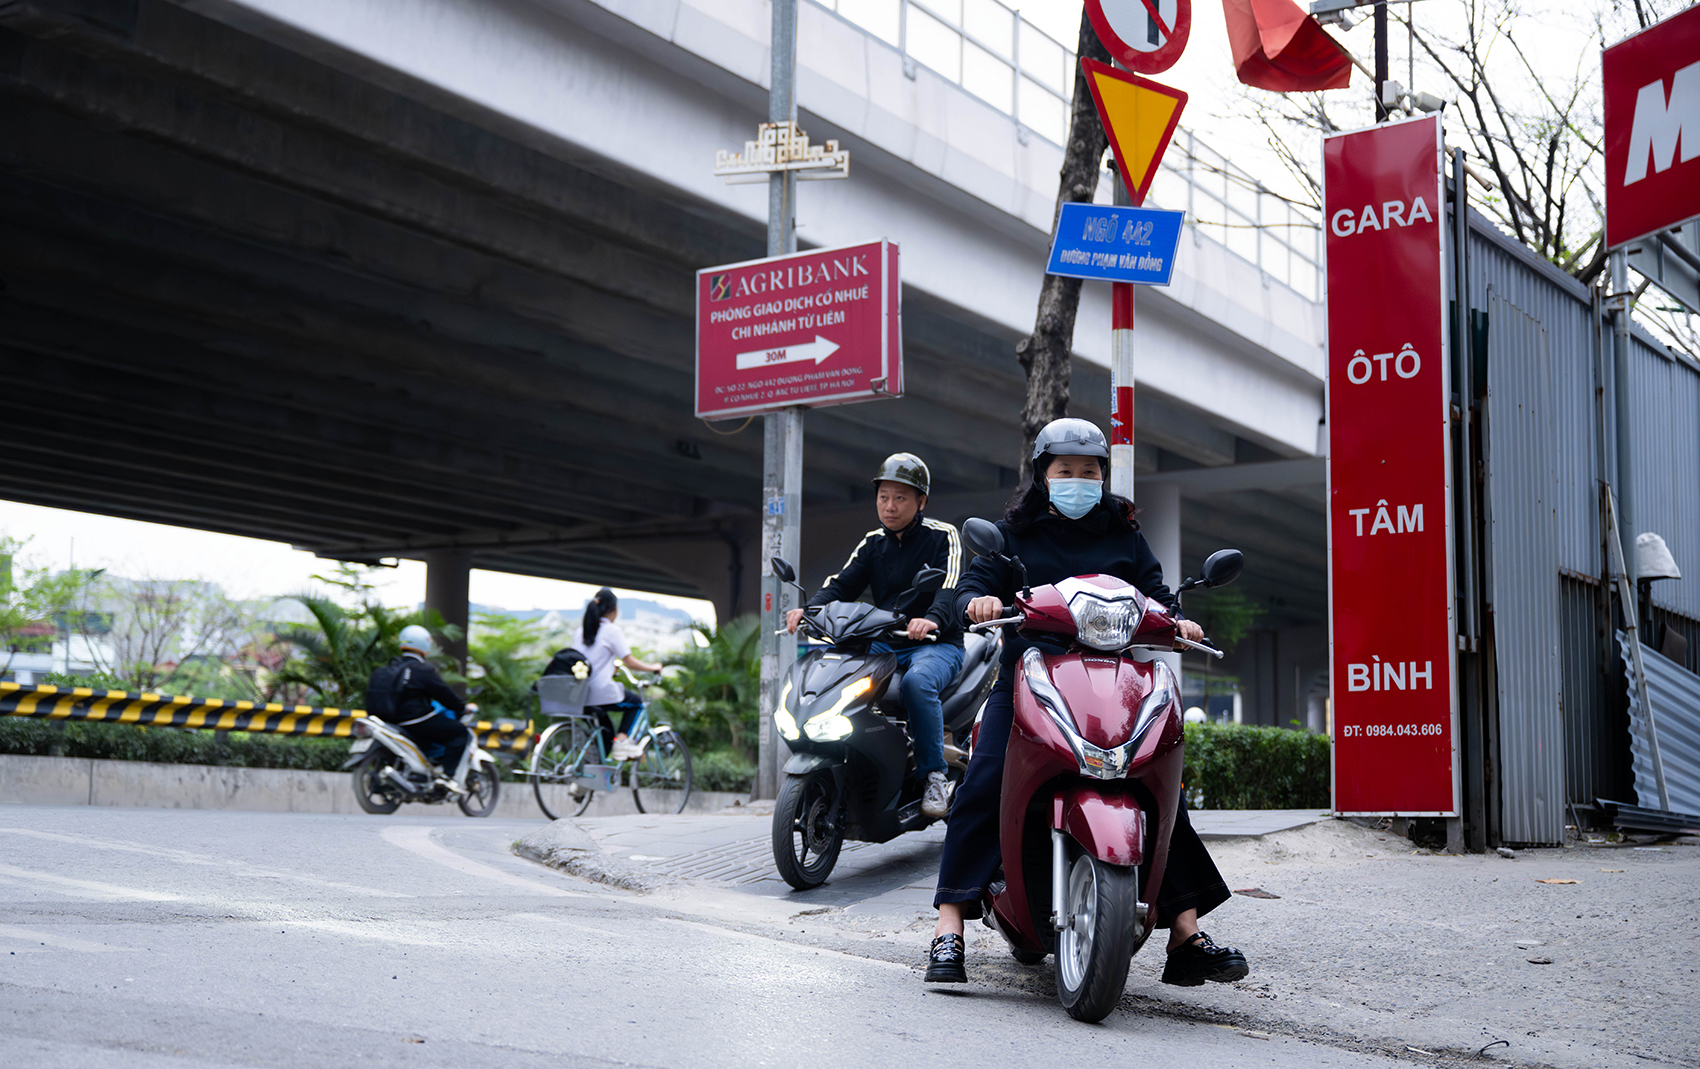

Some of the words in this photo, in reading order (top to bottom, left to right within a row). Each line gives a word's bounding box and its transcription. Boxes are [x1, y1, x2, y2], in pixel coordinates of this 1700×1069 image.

[1082, 213, 1119, 243] NGÕ
[1122, 220, 1154, 246] 442
[1331, 196, 1433, 238] GARA
[735, 254, 869, 298] AGRIBANK
[1060, 248, 1090, 265] ĐƯỜNG
[1092, 253, 1118, 269] PHẠM
[1119, 253, 1137, 269] VĂN
[1137, 251, 1164, 272] ĐỒNG
[710, 305, 752, 324] PHÒNG
[753, 300, 783, 317] GIAO
[784, 295, 813, 315] DỊCH
[815, 288, 833, 307] CỔ
[731, 327, 752, 340] CHI
[753, 319, 796, 337] NHÁNH
[798, 313, 815, 330] TỪ
[816, 309, 846, 326] LIÊM
[765, 349, 787, 364] 30M
[1347, 343, 1421, 385] ÔTÔ
[1349, 499, 1424, 536] TÂM
[1348, 655, 1433, 692] BÌNH
[1343, 725, 1362, 737] ĐT:
[1366, 724, 1442, 737] 0984.043.606
